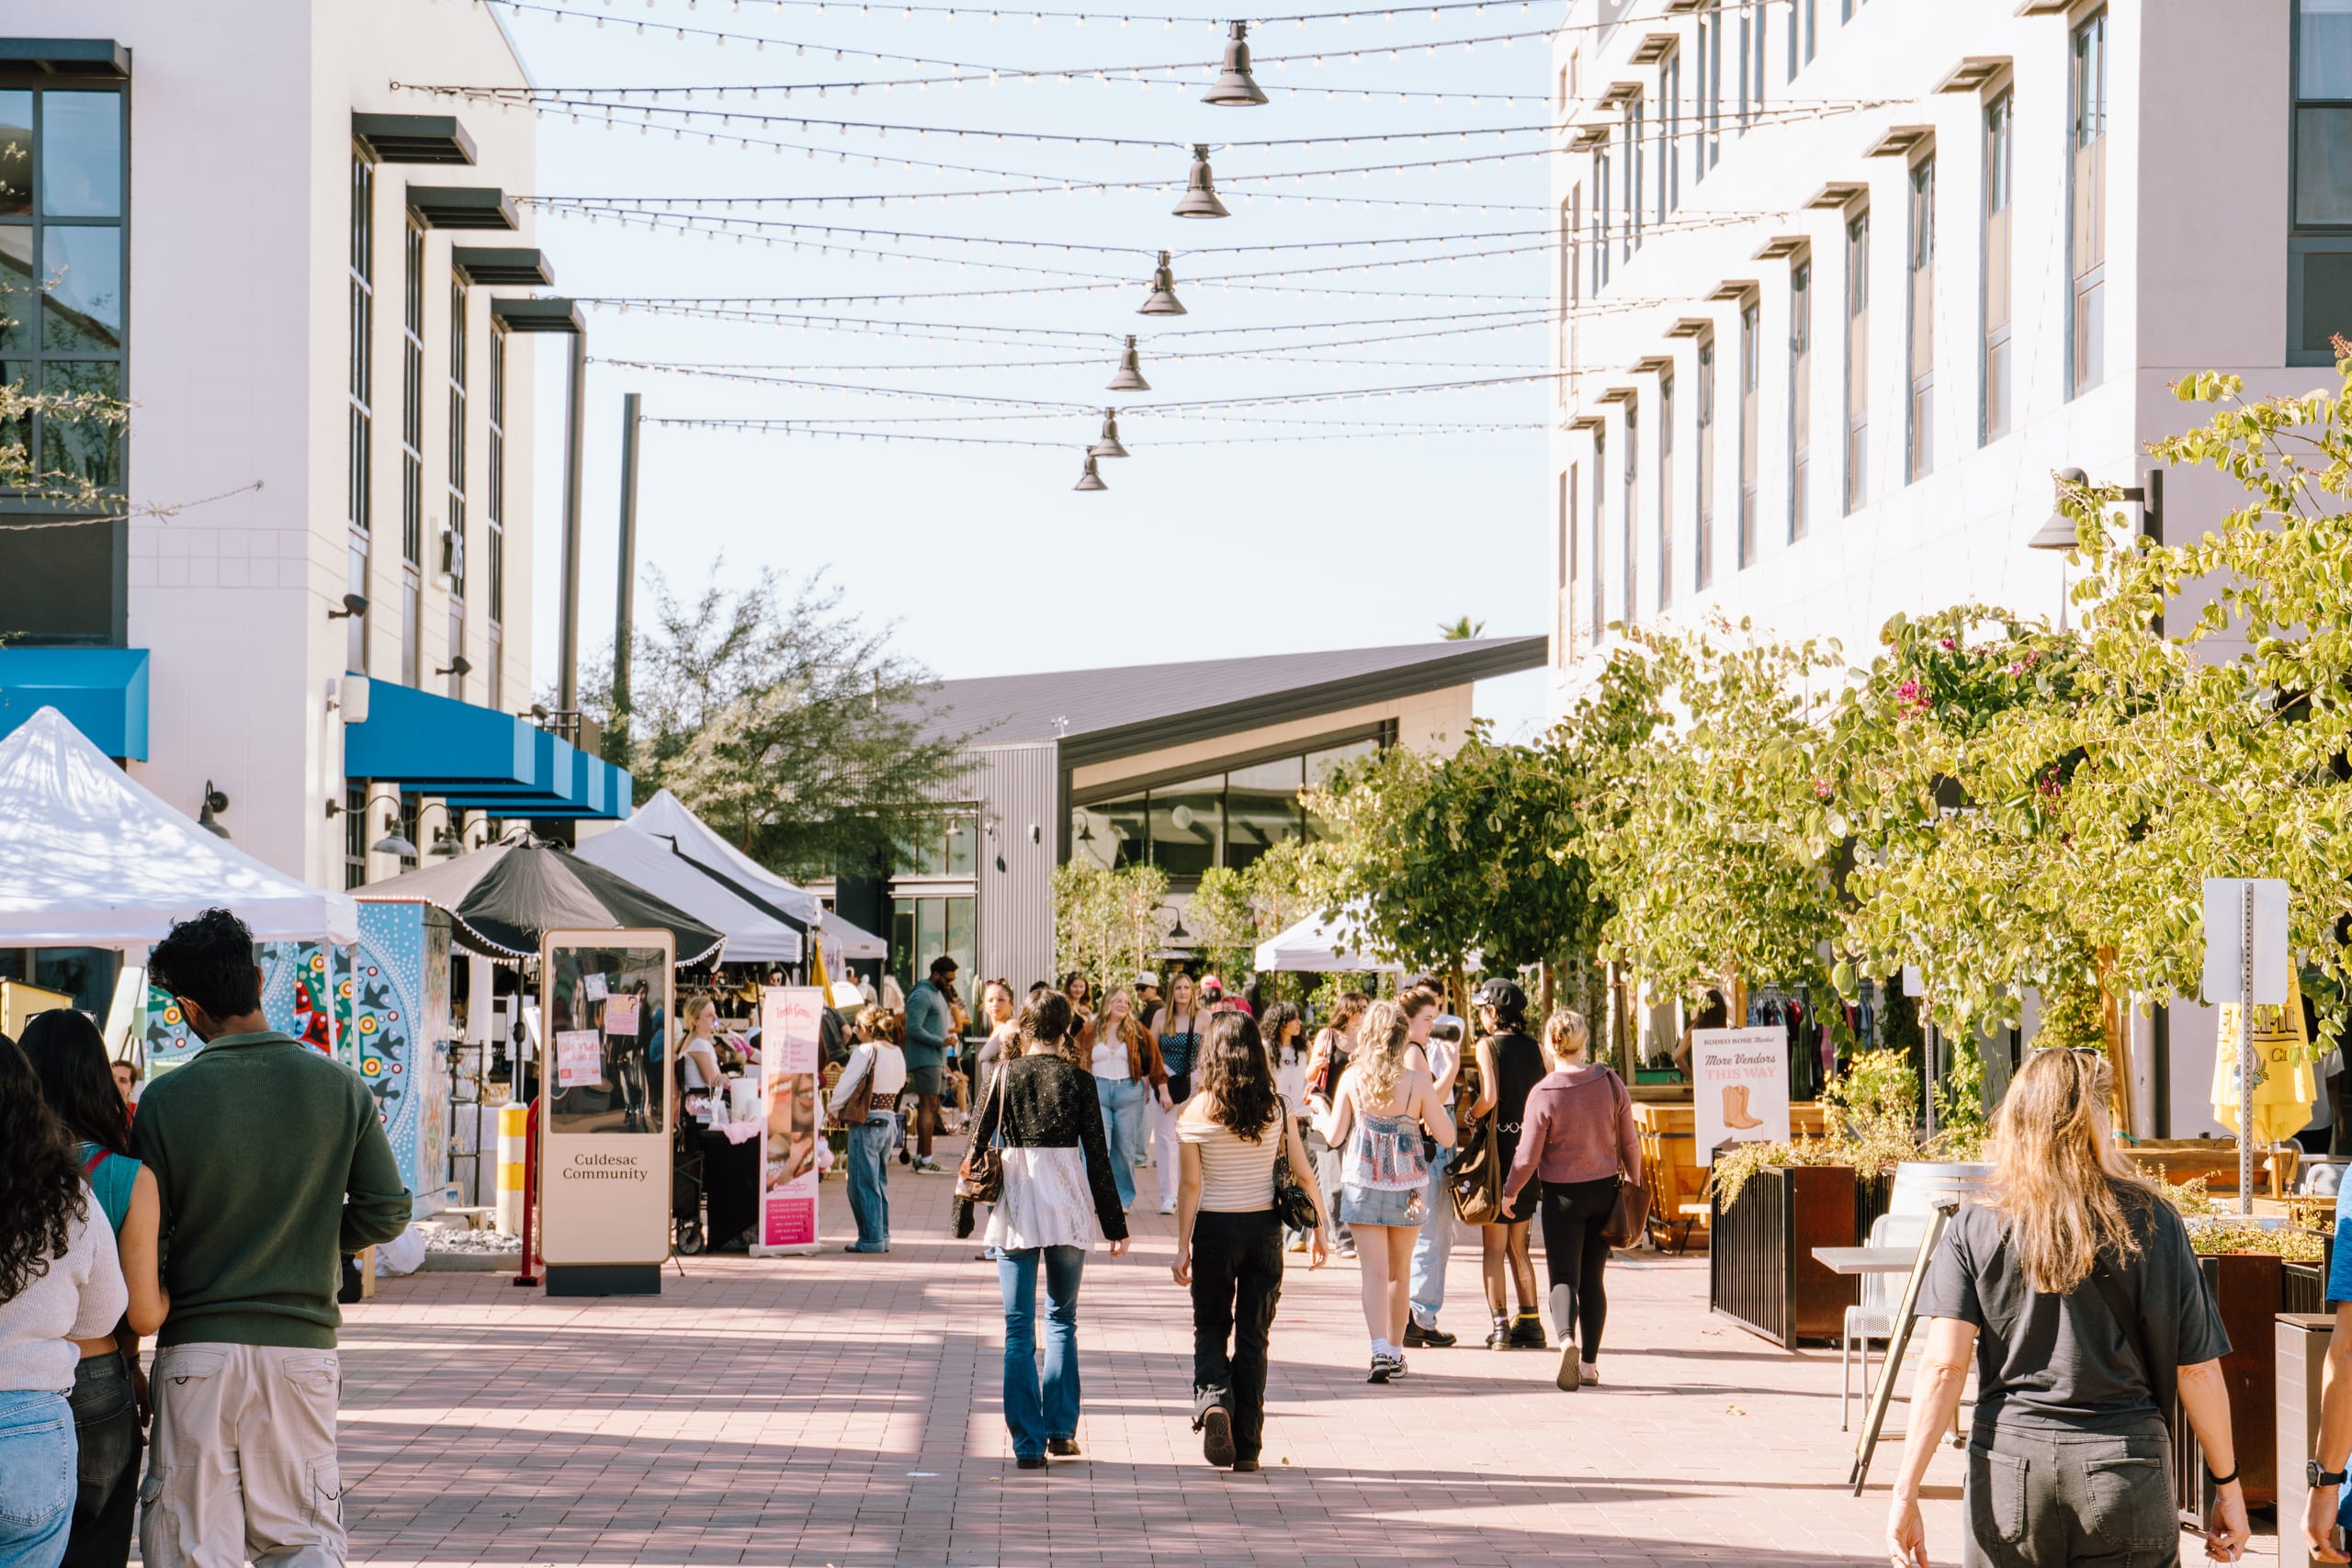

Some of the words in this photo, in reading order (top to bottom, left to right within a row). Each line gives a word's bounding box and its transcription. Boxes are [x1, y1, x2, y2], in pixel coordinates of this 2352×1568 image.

[1705, 1055, 1733, 1066] More
[1734, 1052, 1776, 1065] Vendors
[1705, 1067, 1741, 1080] THIS
[1744, 1066, 1777, 1078] WAY
[574, 1154, 638, 1166] Culdesac
[562, 1168, 648, 1182] Community
